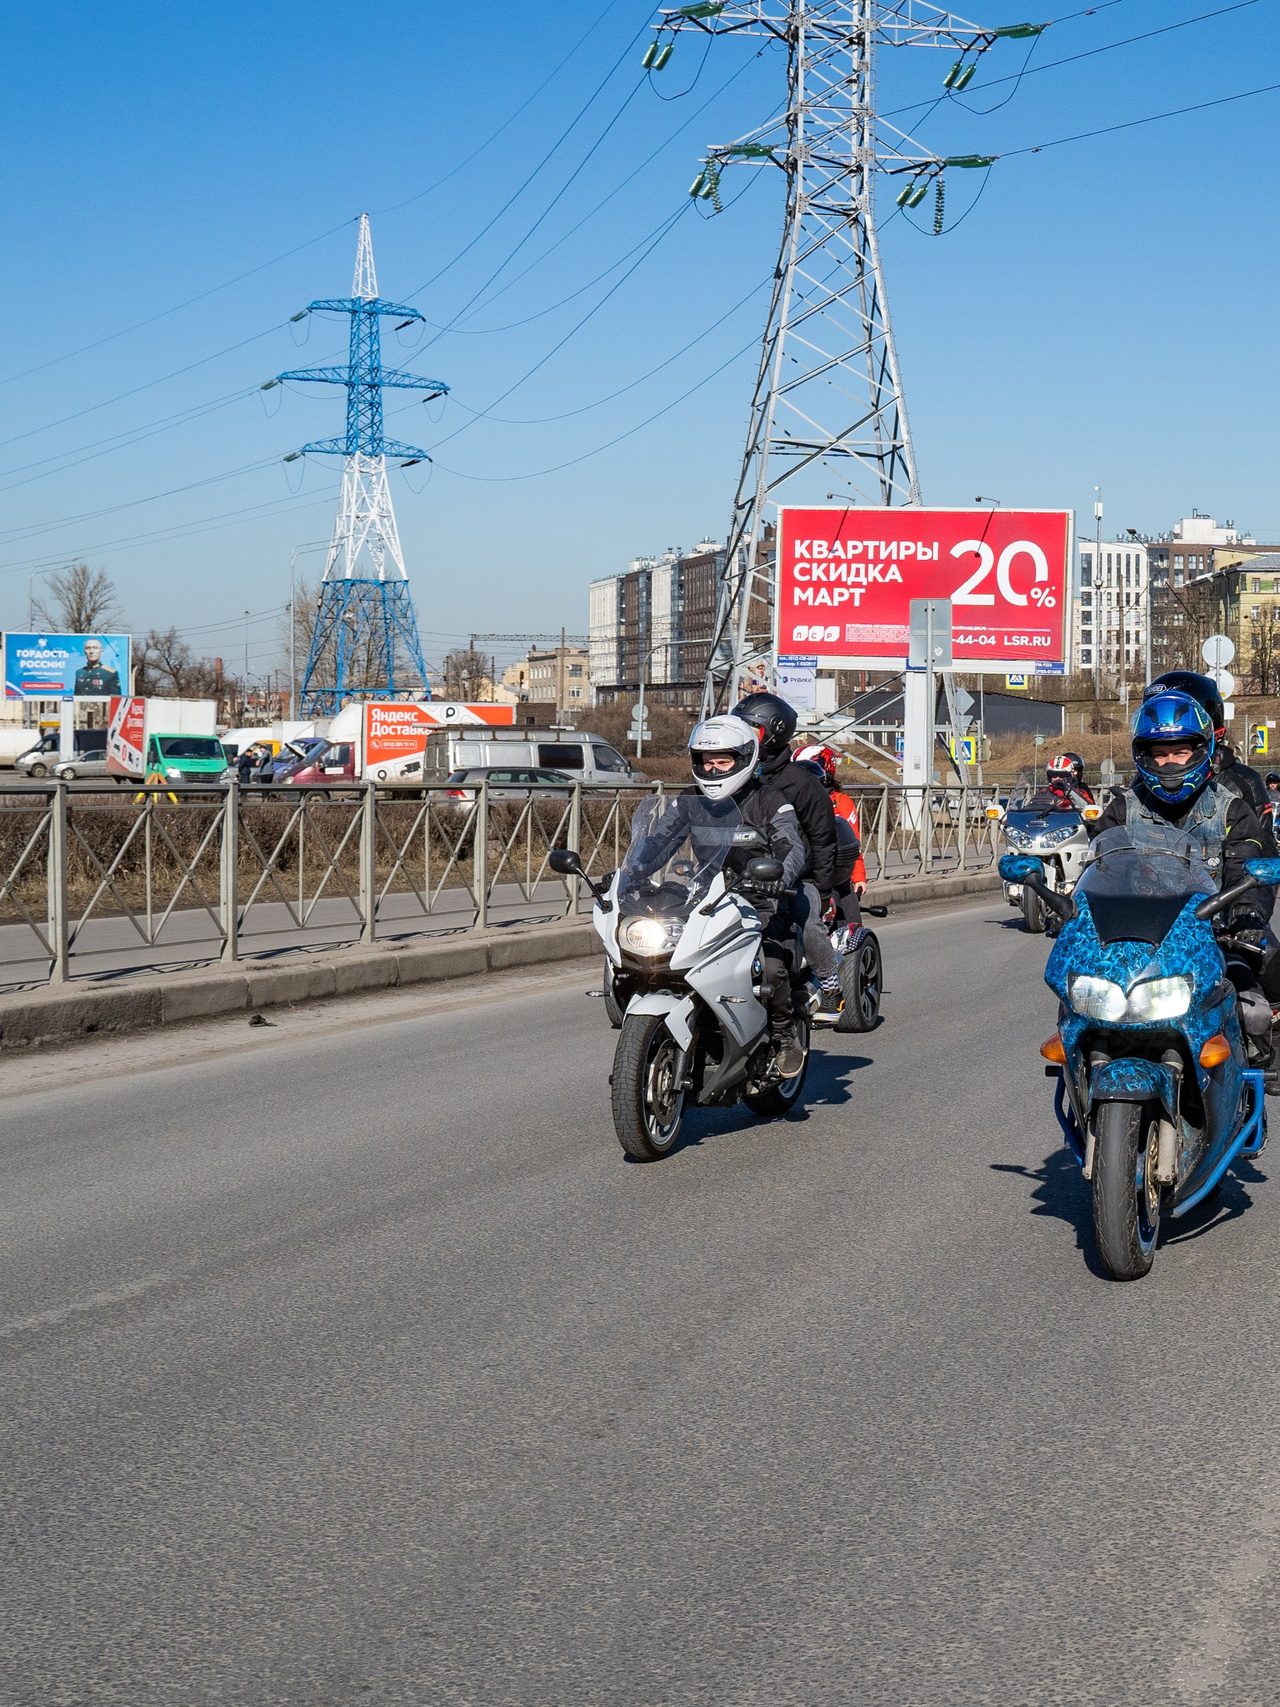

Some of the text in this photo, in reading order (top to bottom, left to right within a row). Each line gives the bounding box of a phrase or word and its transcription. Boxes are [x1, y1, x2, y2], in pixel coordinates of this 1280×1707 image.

[794, 540, 939, 561] КВАРТИРЫ
[793, 563, 903, 586] СКИДКА
[793, 587, 866, 607] МАРТ
[1004, 635, 1051, 647] LSR.RU
[16, 649, 69, 659] ГОРДОСТЬ
[20, 660, 66, 669] РОССИИ!
[371, 708, 418, 723] Яндекс
